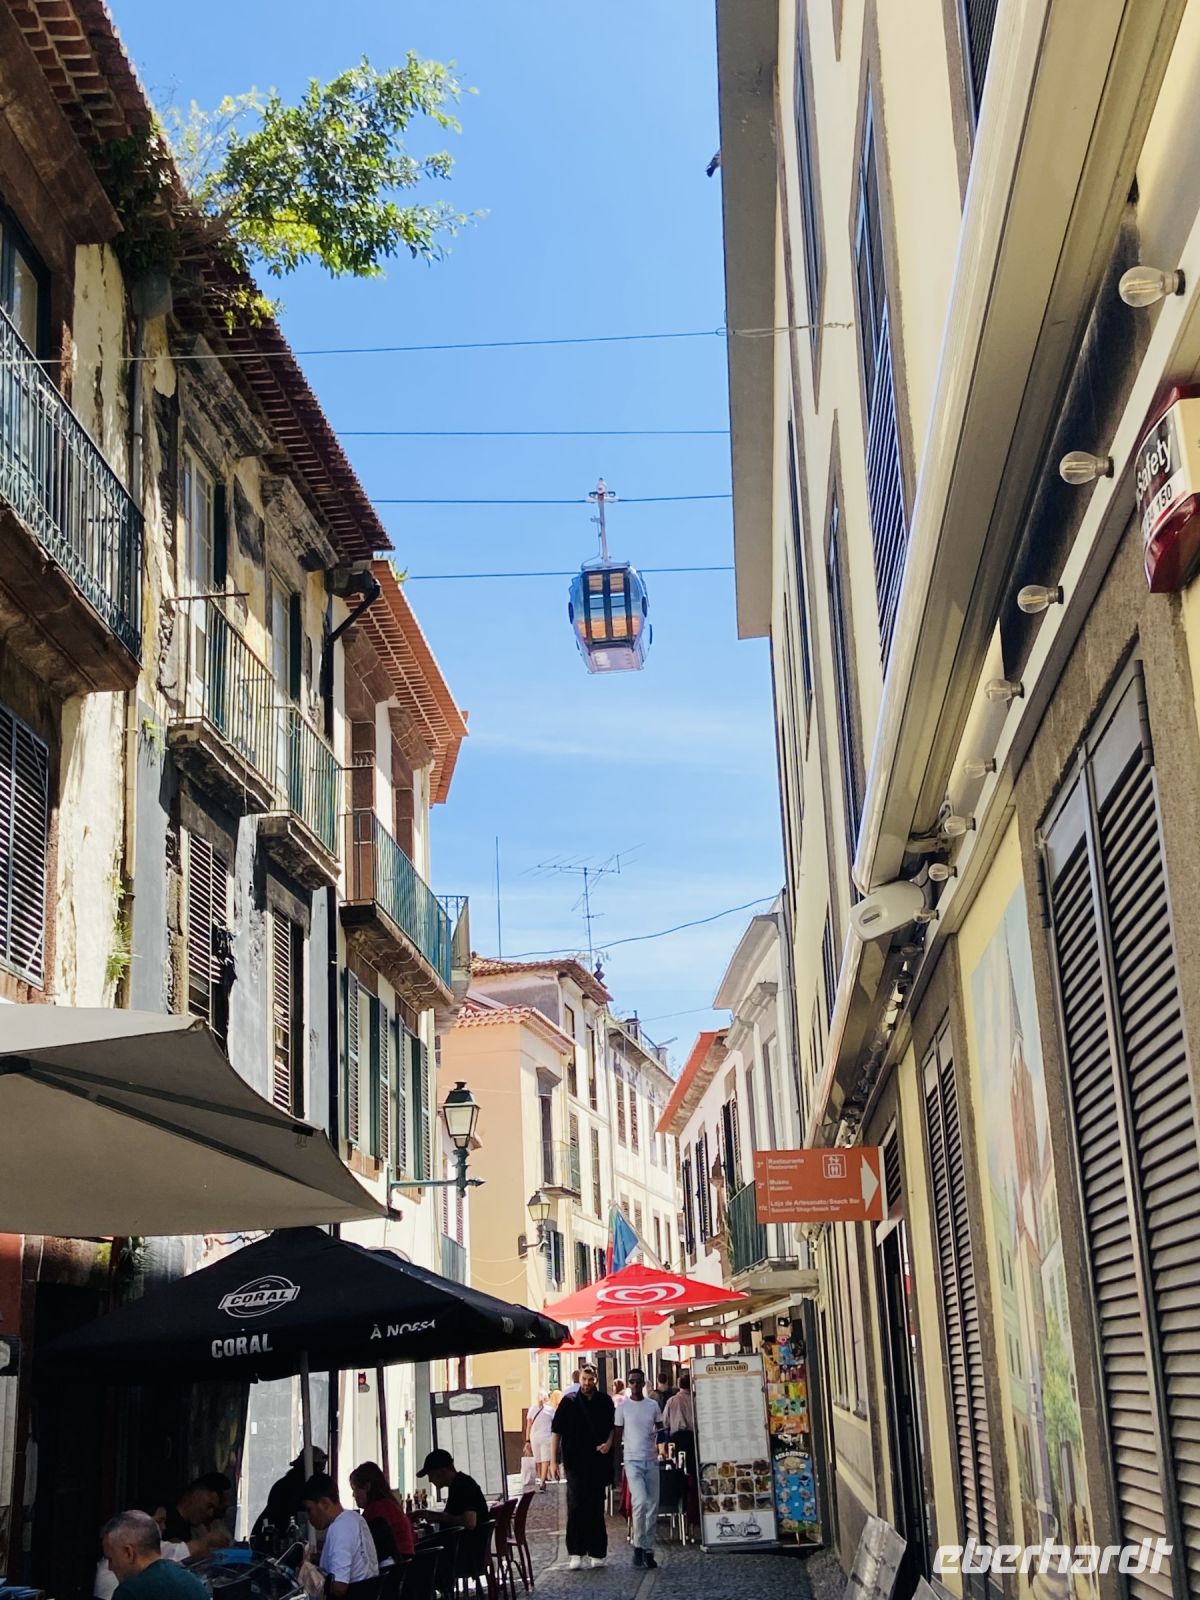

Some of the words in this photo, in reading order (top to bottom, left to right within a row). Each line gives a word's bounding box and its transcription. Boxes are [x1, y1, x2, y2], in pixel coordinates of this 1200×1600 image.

[1157, 484, 1172, 512] 150
[230, 1291, 289, 1305] CORAL
[211, 1333, 273, 1358] CORAL
